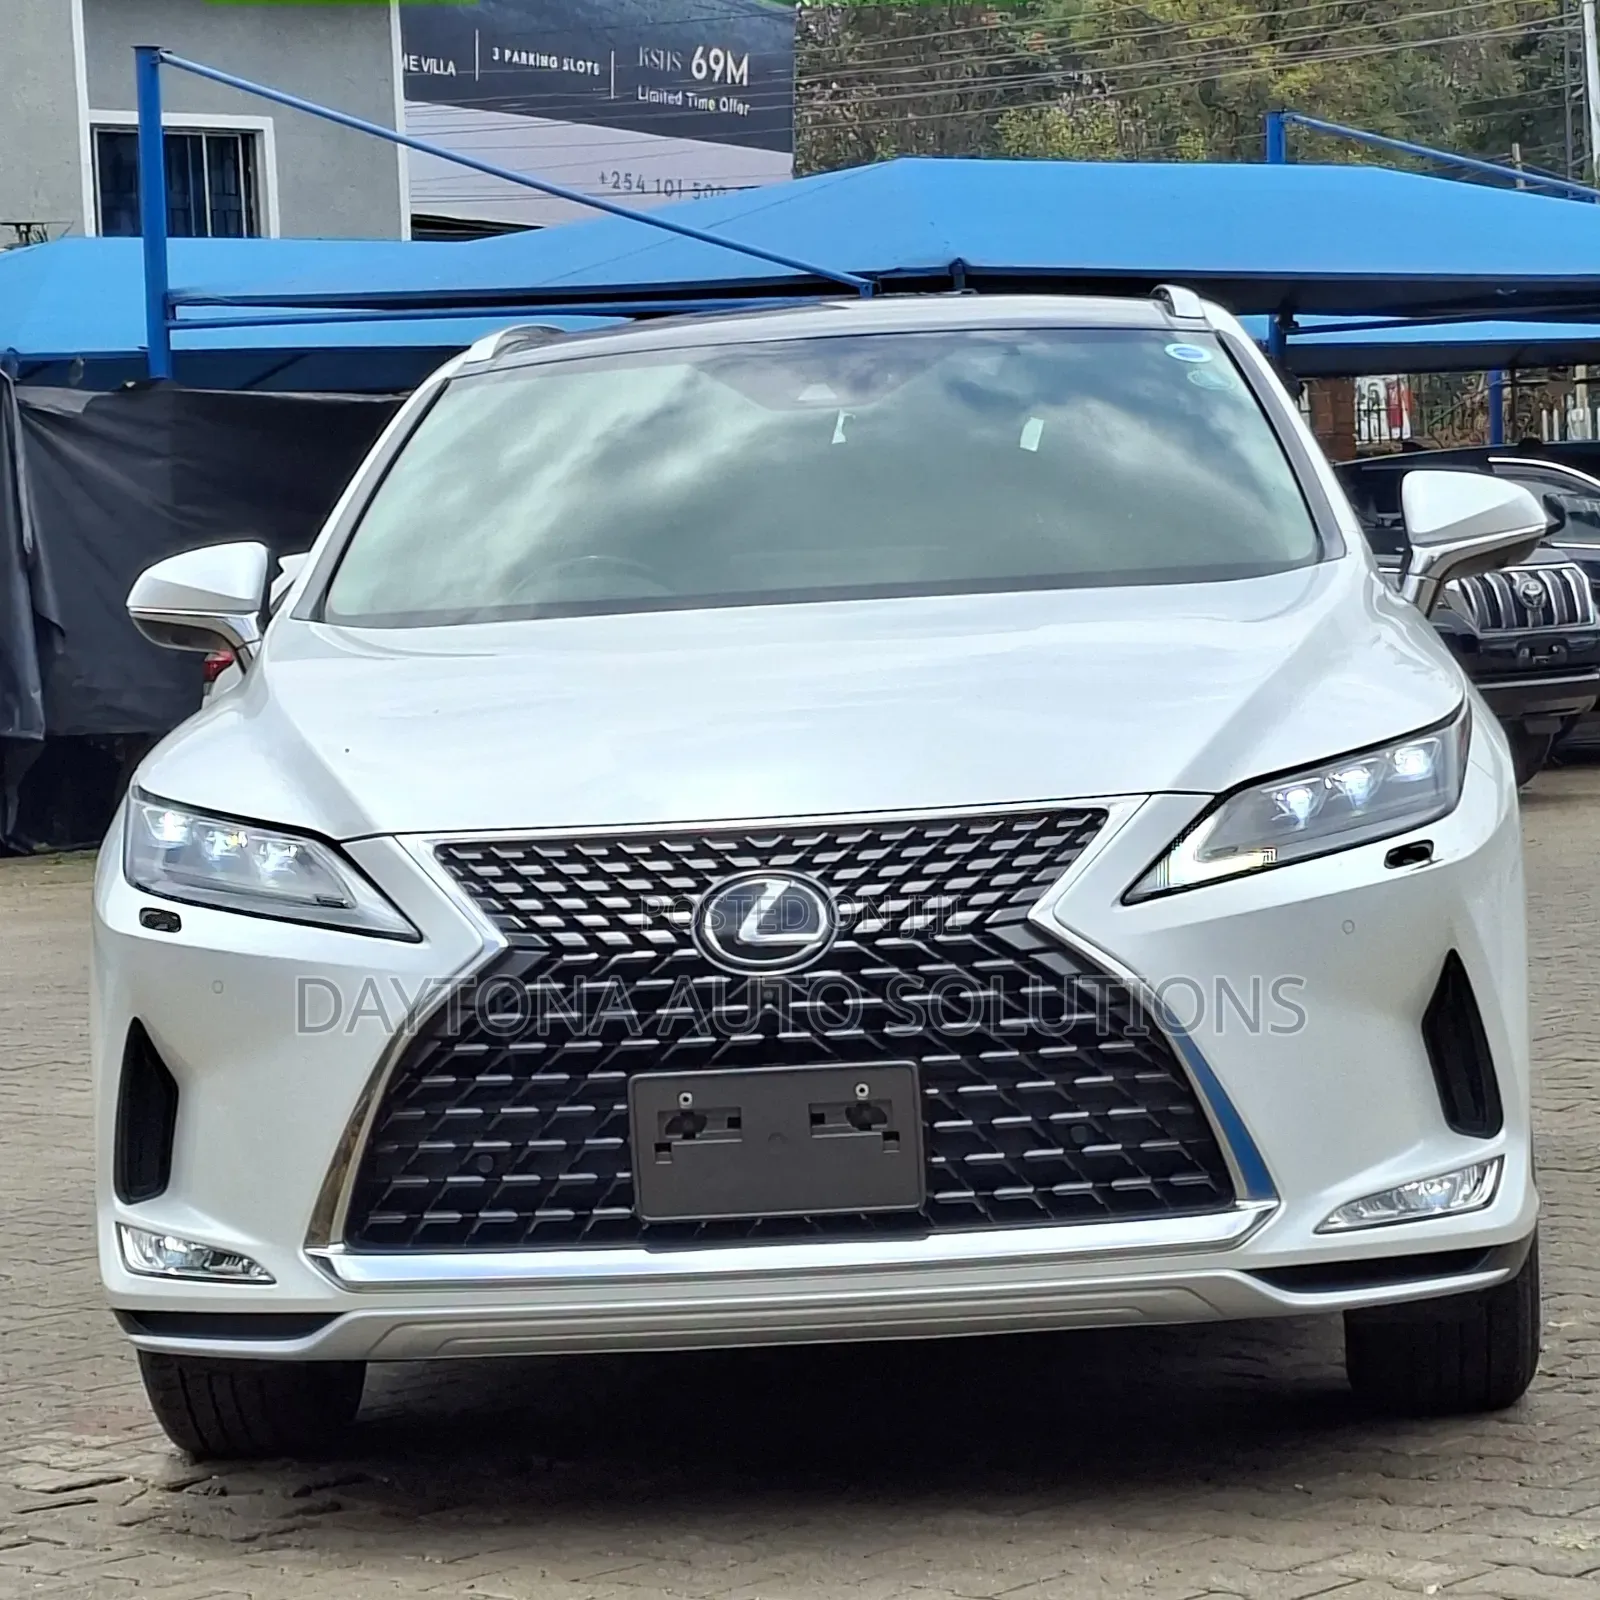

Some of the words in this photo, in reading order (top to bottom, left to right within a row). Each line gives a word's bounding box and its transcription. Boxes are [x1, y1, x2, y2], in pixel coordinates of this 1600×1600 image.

[421, 55, 456, 76] VILLA
[492, 47, 500, 61] 3
[504, 49, 558, 69] PARKING
[562, 57, 601, 76] SLOTS
[691, 45, 749, 87] 69M
[637, 84, 683, 106] Limited
[685, 91, 716, 111] Time
[720, 97, 750, 116] Offer
[598, 170, 645, 194] +254
